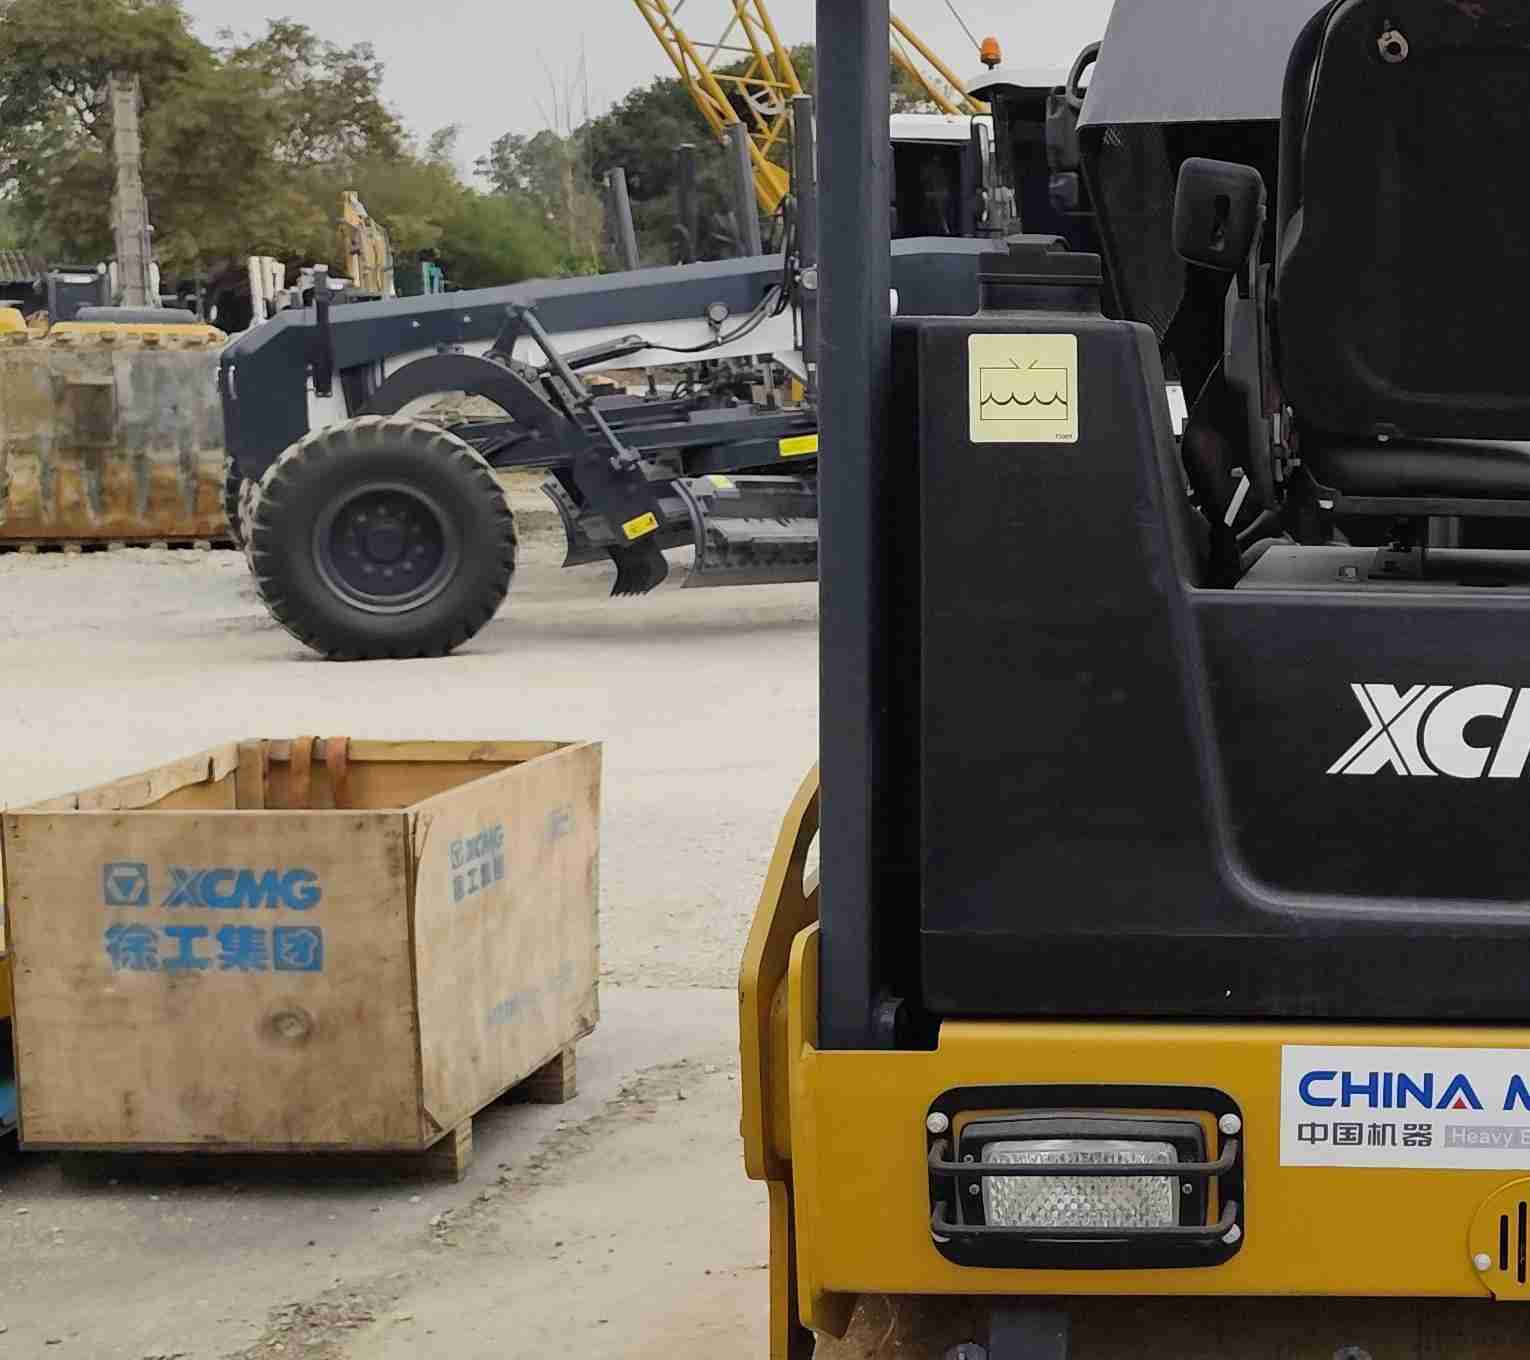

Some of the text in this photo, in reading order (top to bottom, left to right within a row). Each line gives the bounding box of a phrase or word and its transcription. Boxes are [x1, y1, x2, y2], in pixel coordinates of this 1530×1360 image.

[162, 868, 321, 910] XCMG
[104, 923, 324, 973] 徐工集团
[1297, 1070, 1484, 1111] CHINA
[1297, 1121, 1433, 1148] 中国机器
[1451, 1127, 1514, 1147] Heavy
